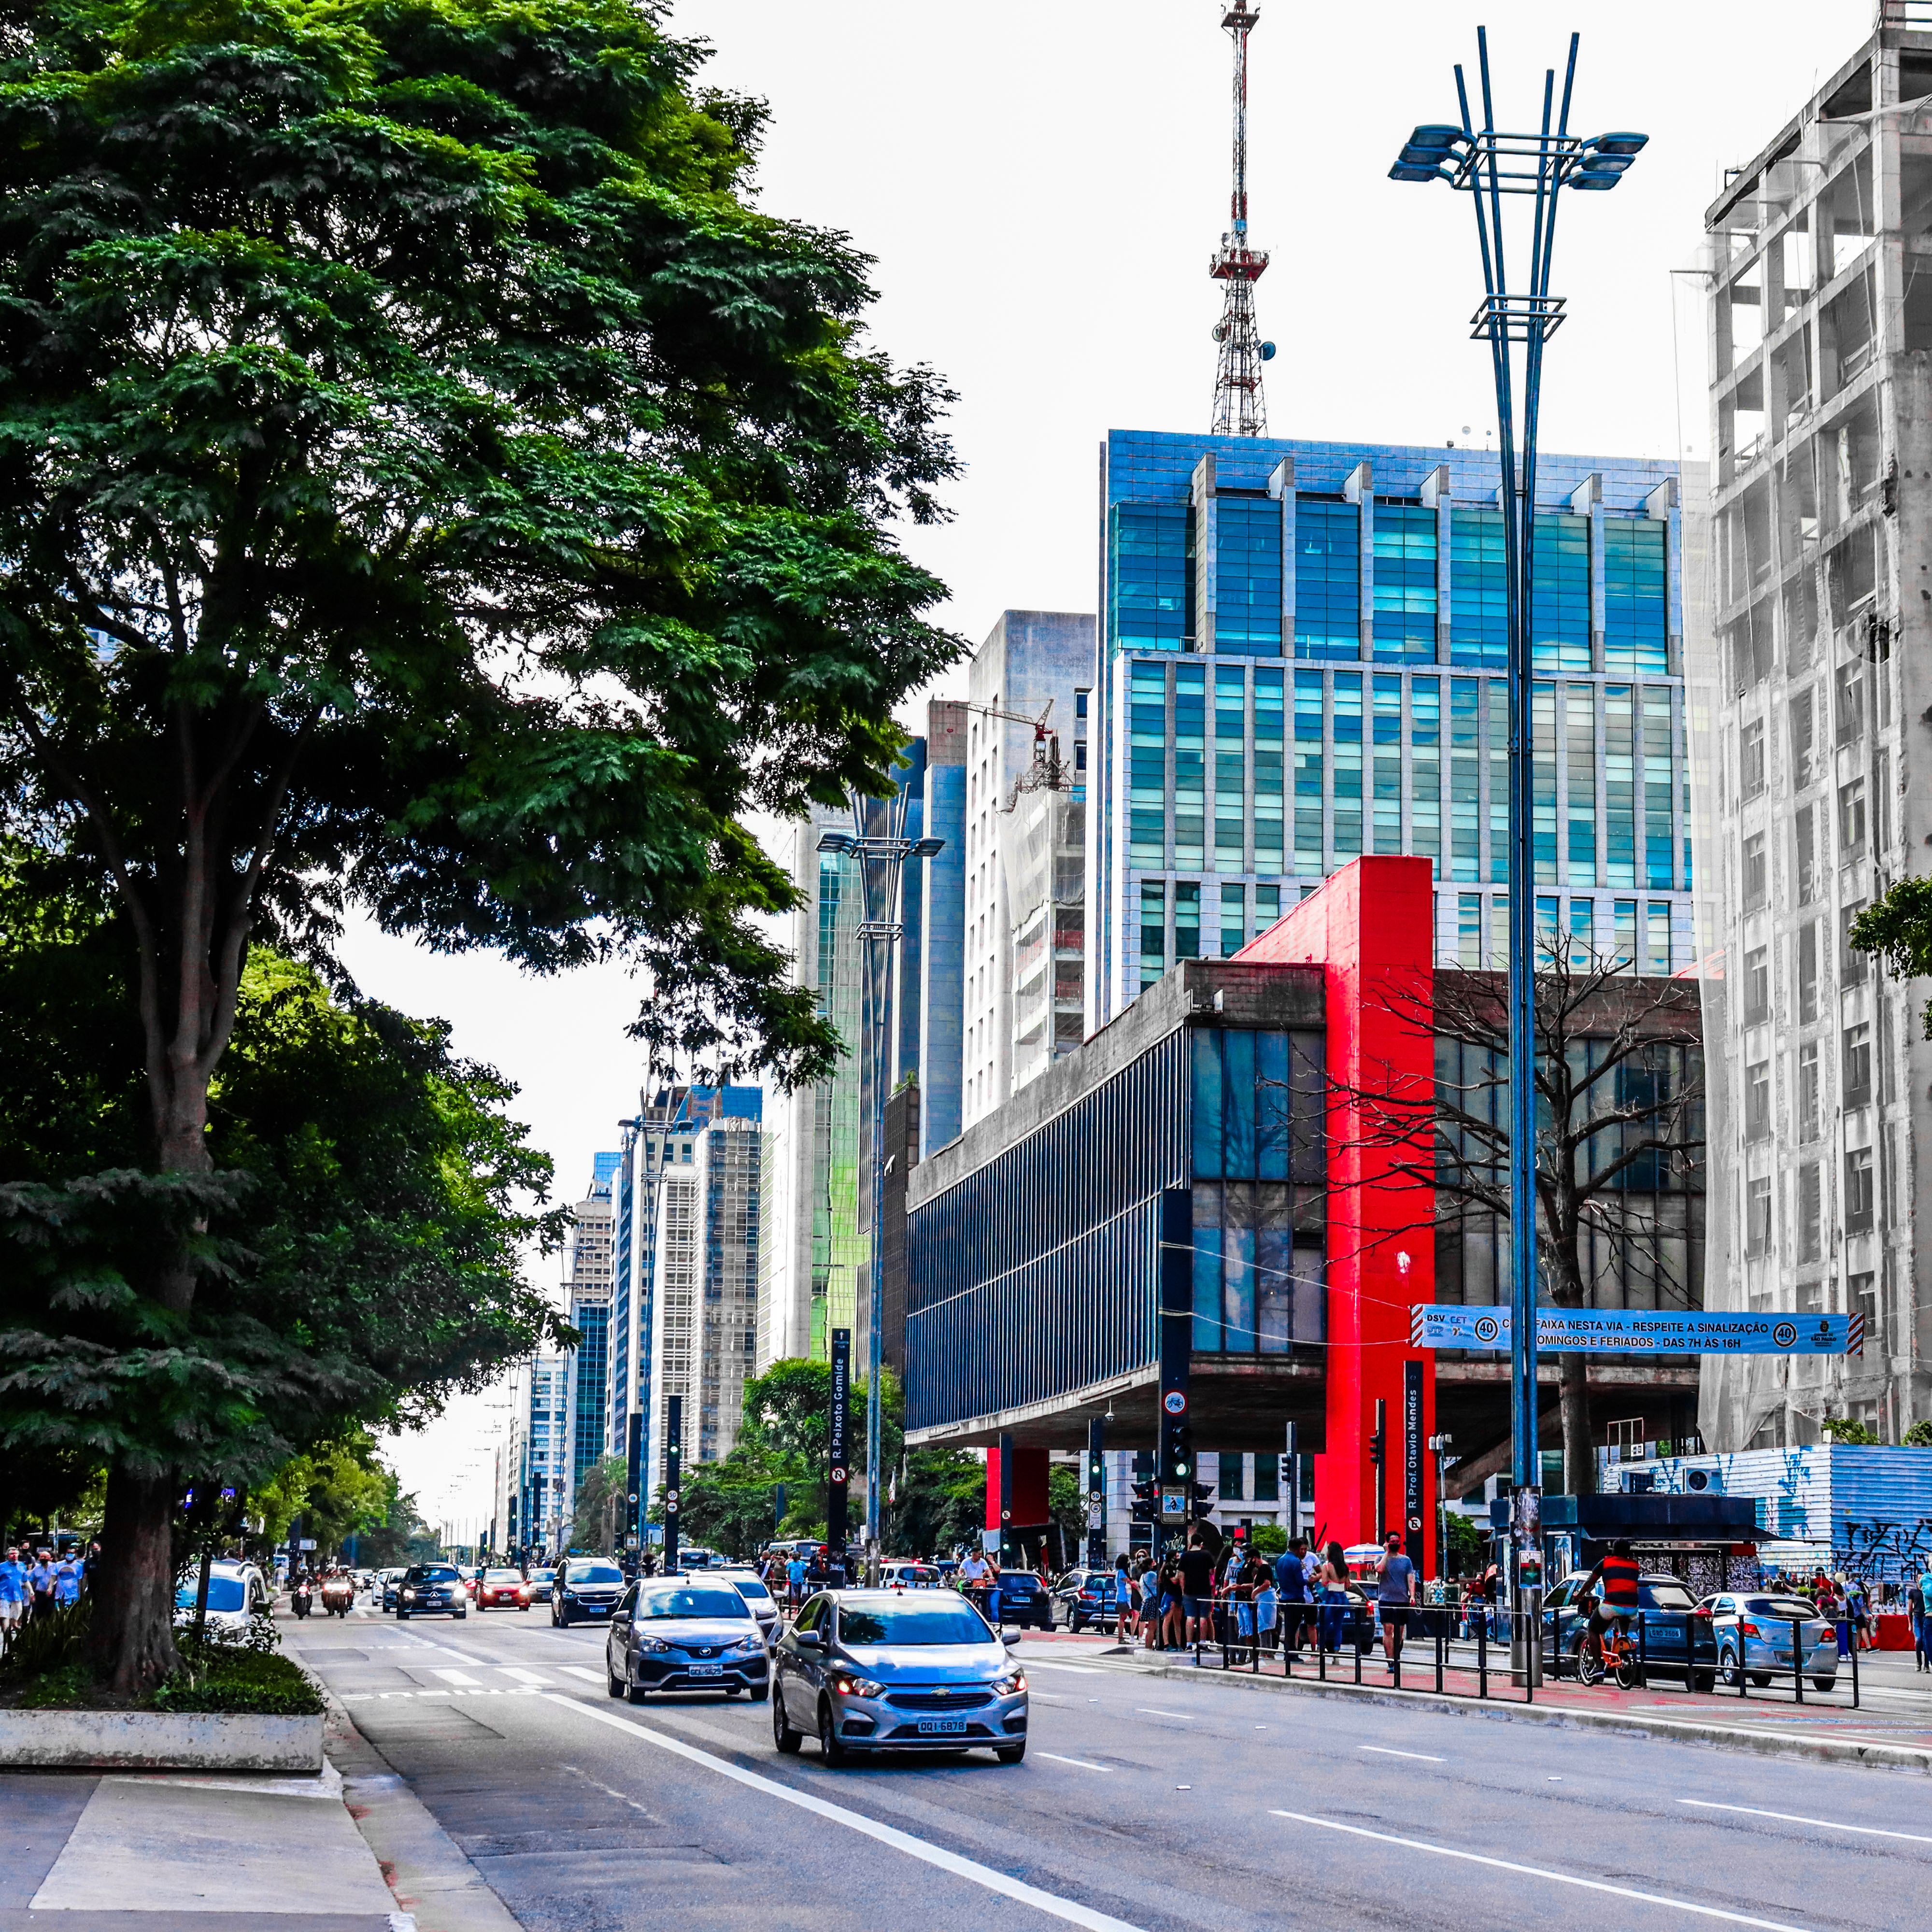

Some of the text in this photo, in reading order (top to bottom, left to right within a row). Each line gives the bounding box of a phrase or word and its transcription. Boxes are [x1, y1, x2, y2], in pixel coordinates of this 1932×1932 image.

[1480, 1322, 1493, 1333] 40
[1568, 1321, 1603, 1330] NESTA
[1606, 1321, 1623, 1331] VIA
[1633, 1322, 1683, 1332] RESPEITE
[1687, 1323, 1694, 1332] A
[1698, 1321, 1768, 1335] SINALIZAÇÃO
[1778, 1328, 1791, 1338] 40
[1537, 1335, 1587, 1346] OMINGOS
[1591, 1337, 1597, 1346] E
[1601, 1337, 1653, 1347] FERIADOS
[1663, 1338, 1685, 1347] DAS
[1688, 1338, 1701, 1347] 7H
[1705, 1336, 1719, 1348] ÀS
[1722, 1339, 1740, 1348] 16H
[832, 1358, 844, 1459] R. Peixoto Gomide
[1408, 1390, 1417, 1430] Mendes
[1408, 1471, 1417, 1496] Prof.
[1408, 1499, 1417, 1508] R.
